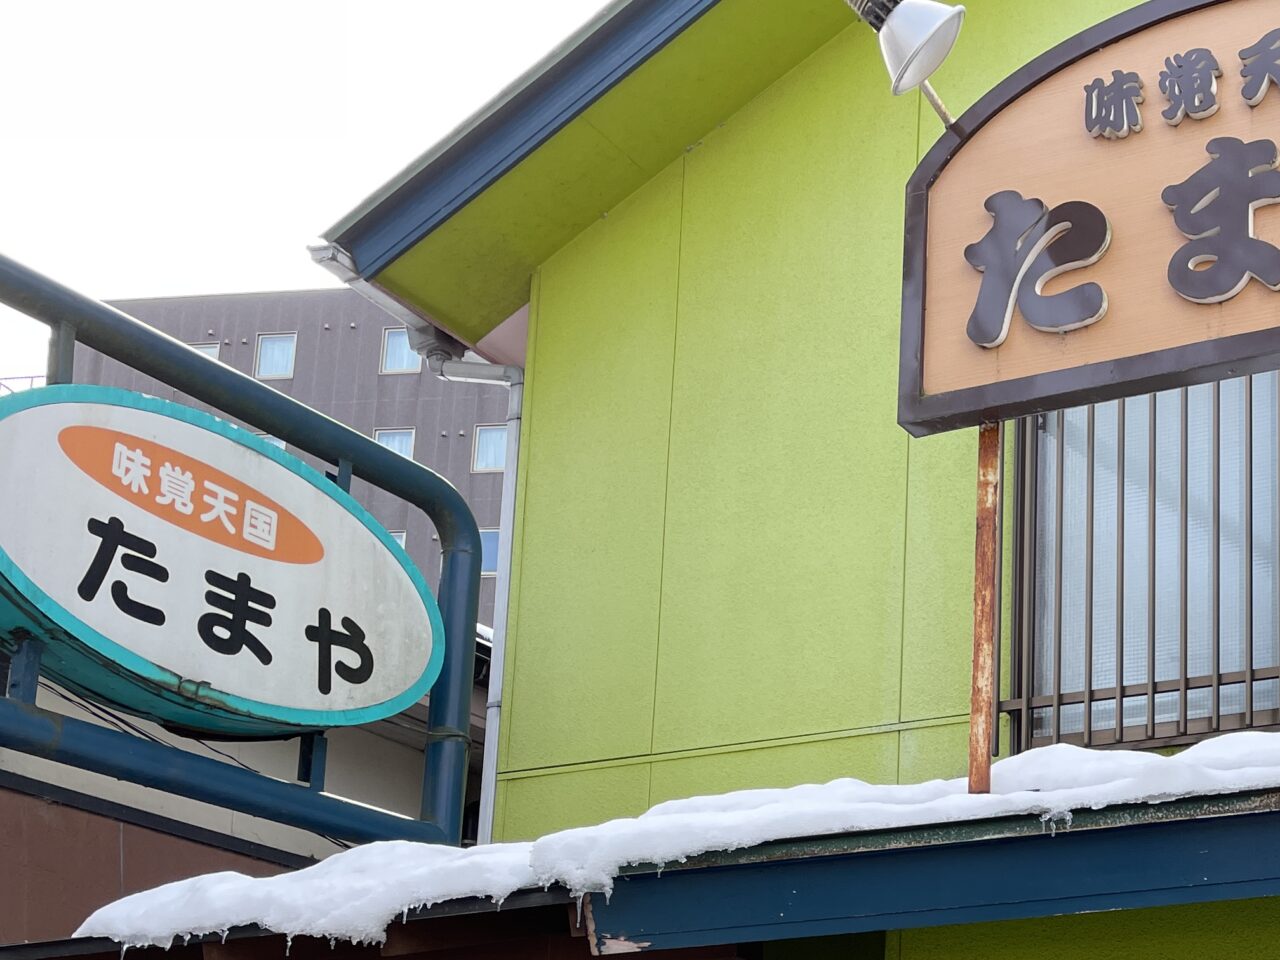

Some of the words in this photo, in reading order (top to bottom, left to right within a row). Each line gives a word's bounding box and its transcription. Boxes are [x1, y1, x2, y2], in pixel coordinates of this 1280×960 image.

[111, 441, 279, 552] 味覚天国
[77, 516, 375, 696] たまや
